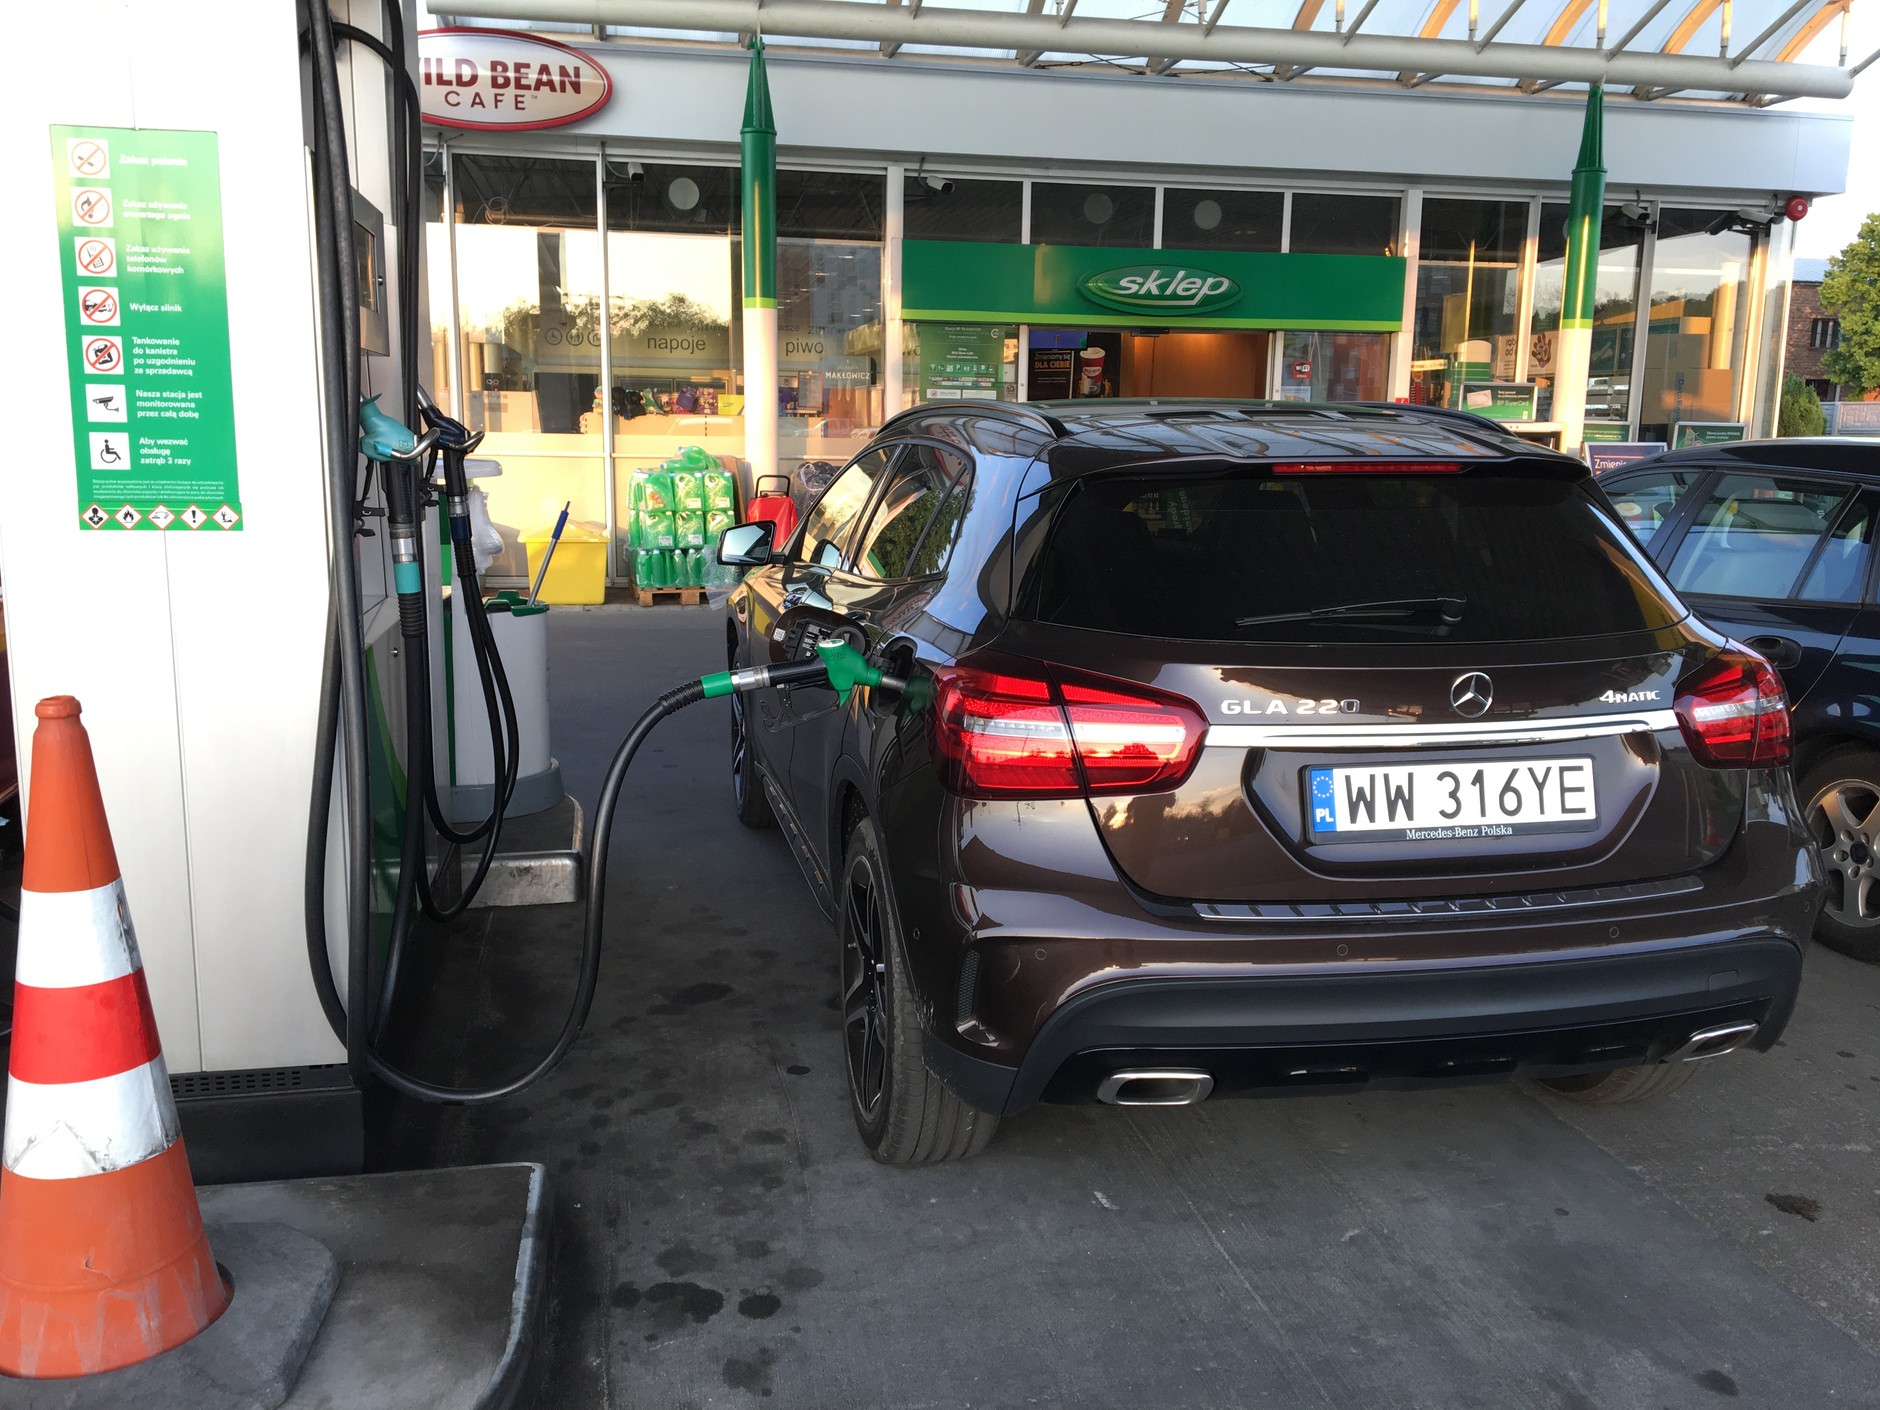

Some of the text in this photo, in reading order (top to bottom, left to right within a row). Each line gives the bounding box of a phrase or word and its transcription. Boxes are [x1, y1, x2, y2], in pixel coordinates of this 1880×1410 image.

[420, 57, 581, 95] ILD BEAN
[444, 90, 526, 110] CAFE
[127, 265, 184, 275] komórkowych
[1118, 269, 1231, 306] sklep
[129, 303, 182, 313] Wyłącz silnik
[132, 336, 180, 346] Tankowanie
[647, 335, 706, 355] napoje
[145, 347, 178, 355] kanistra
[785, 339, 824, 357] piwo
[146, 357, 196, 366] uzgodnieniu
[1034, 361, 1049, 369] DLA
[145, 367, 193, 377] sprzedawcą
[825, 371, 871, 380] MAKŁOWICZ
[135, 389, 203, 400] Nasza stacja jest
[136, 400, 196, 408] monitorowana
[137, 410, 199, 419] przez całą dobę
[139, 437, 188, 447] Aby wezwać
[140, 446, 171, 456] obsługę
[140, 456, 166, 466] zatrąb
[174, 458, 192, 466] razy
[1599, 690, 1660, 703] 4MATIC
[1221, 698, 1360, 715] GLA 220
[1345, 766, 1586, 824] WW 316YE
[1315, 808, 1334, 823] PL
[1406, 826, 1513, 839] Mercedes-Benz Polska
